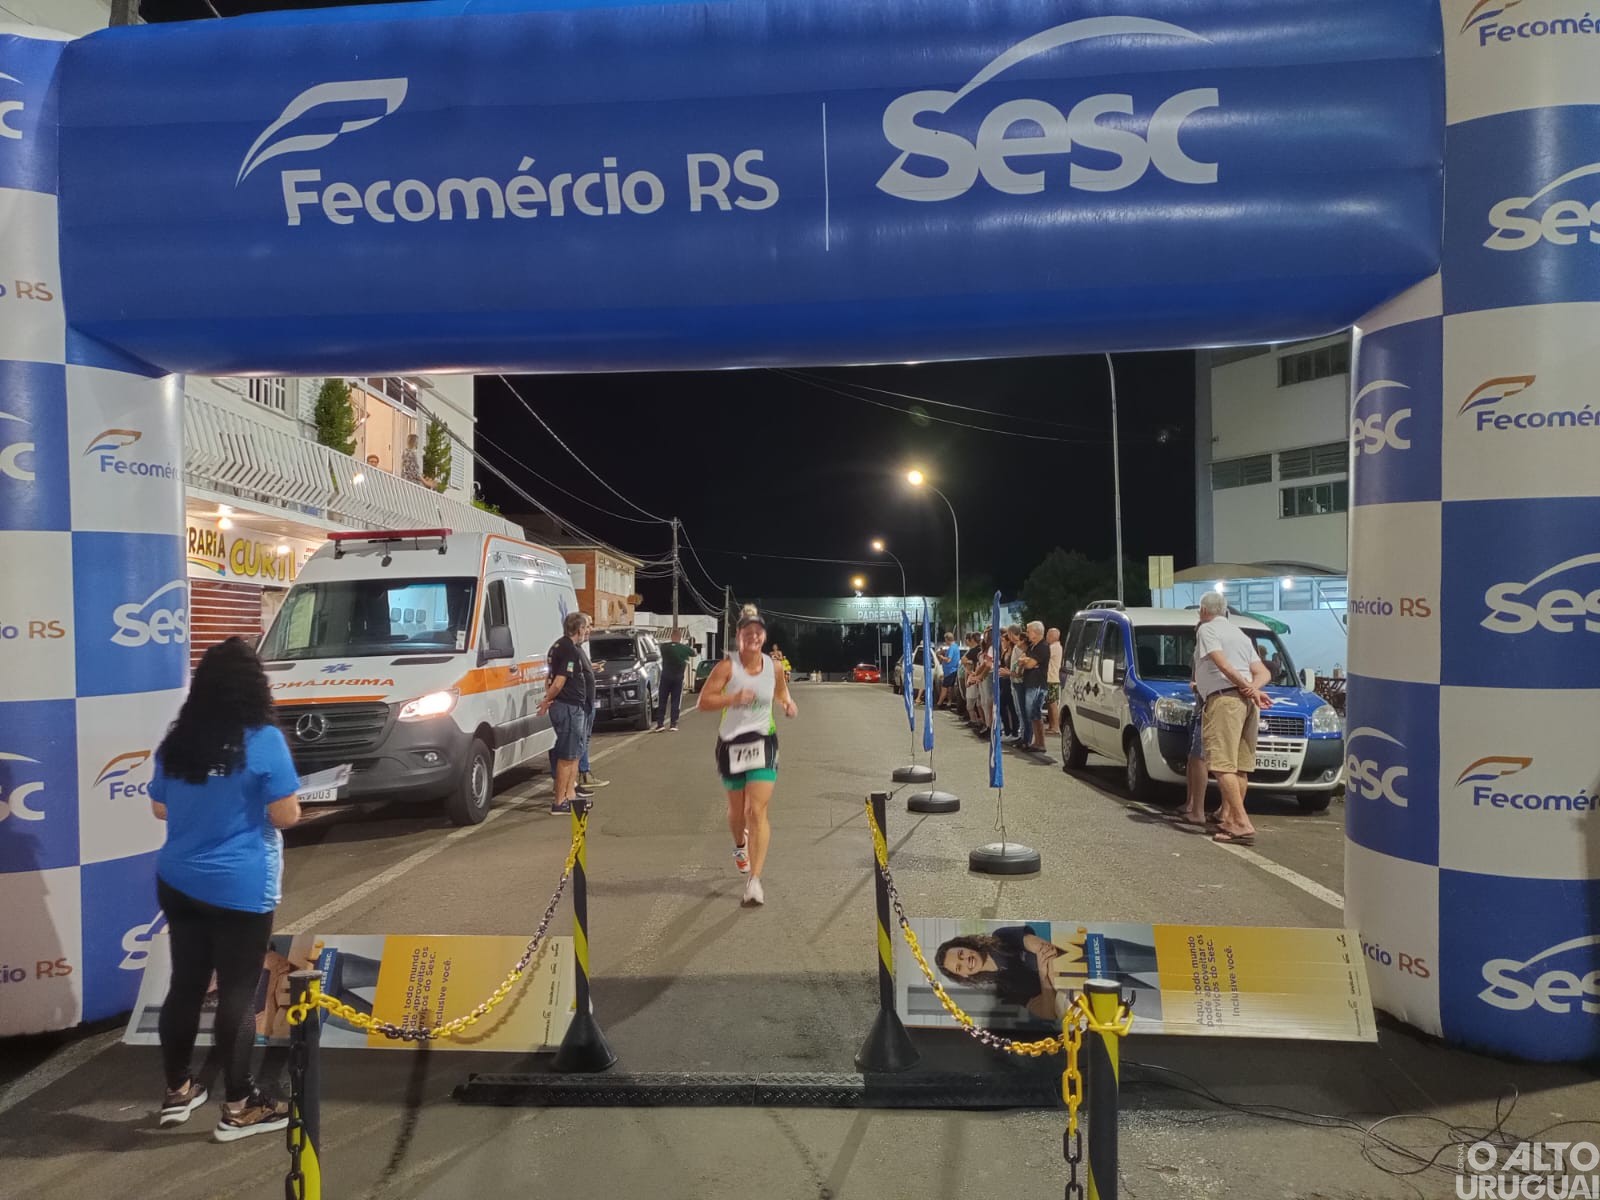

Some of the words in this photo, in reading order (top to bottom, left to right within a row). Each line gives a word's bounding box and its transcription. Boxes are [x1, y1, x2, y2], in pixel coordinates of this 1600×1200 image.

[875, 86, 1220, 202] Sesc
[281, 155, 665, 226] Fecomércio
[686, 149, 780, 212] RS
[15, 279, 53, 302] RS
[186, 526, 226, 559] RARiA
[1399, 597, 1432, 618] RS
[28, 620, 66, 640] RS
[110, 602, 189, 648] Ses
[408, 948, 421, 983] mundo
[1050, 926, 1089, 991] IM.
[1186, 936, 1199, 969] mundo
[1399, 952, 1431, 978] RS
[35, 957, 73, 980] RS
[1209, 965, 1218, 979] do
[403, 985, 414, 1009] todo
[412, 960, 426, 1011] aproveitar
[422, 979, 432, 992] do
